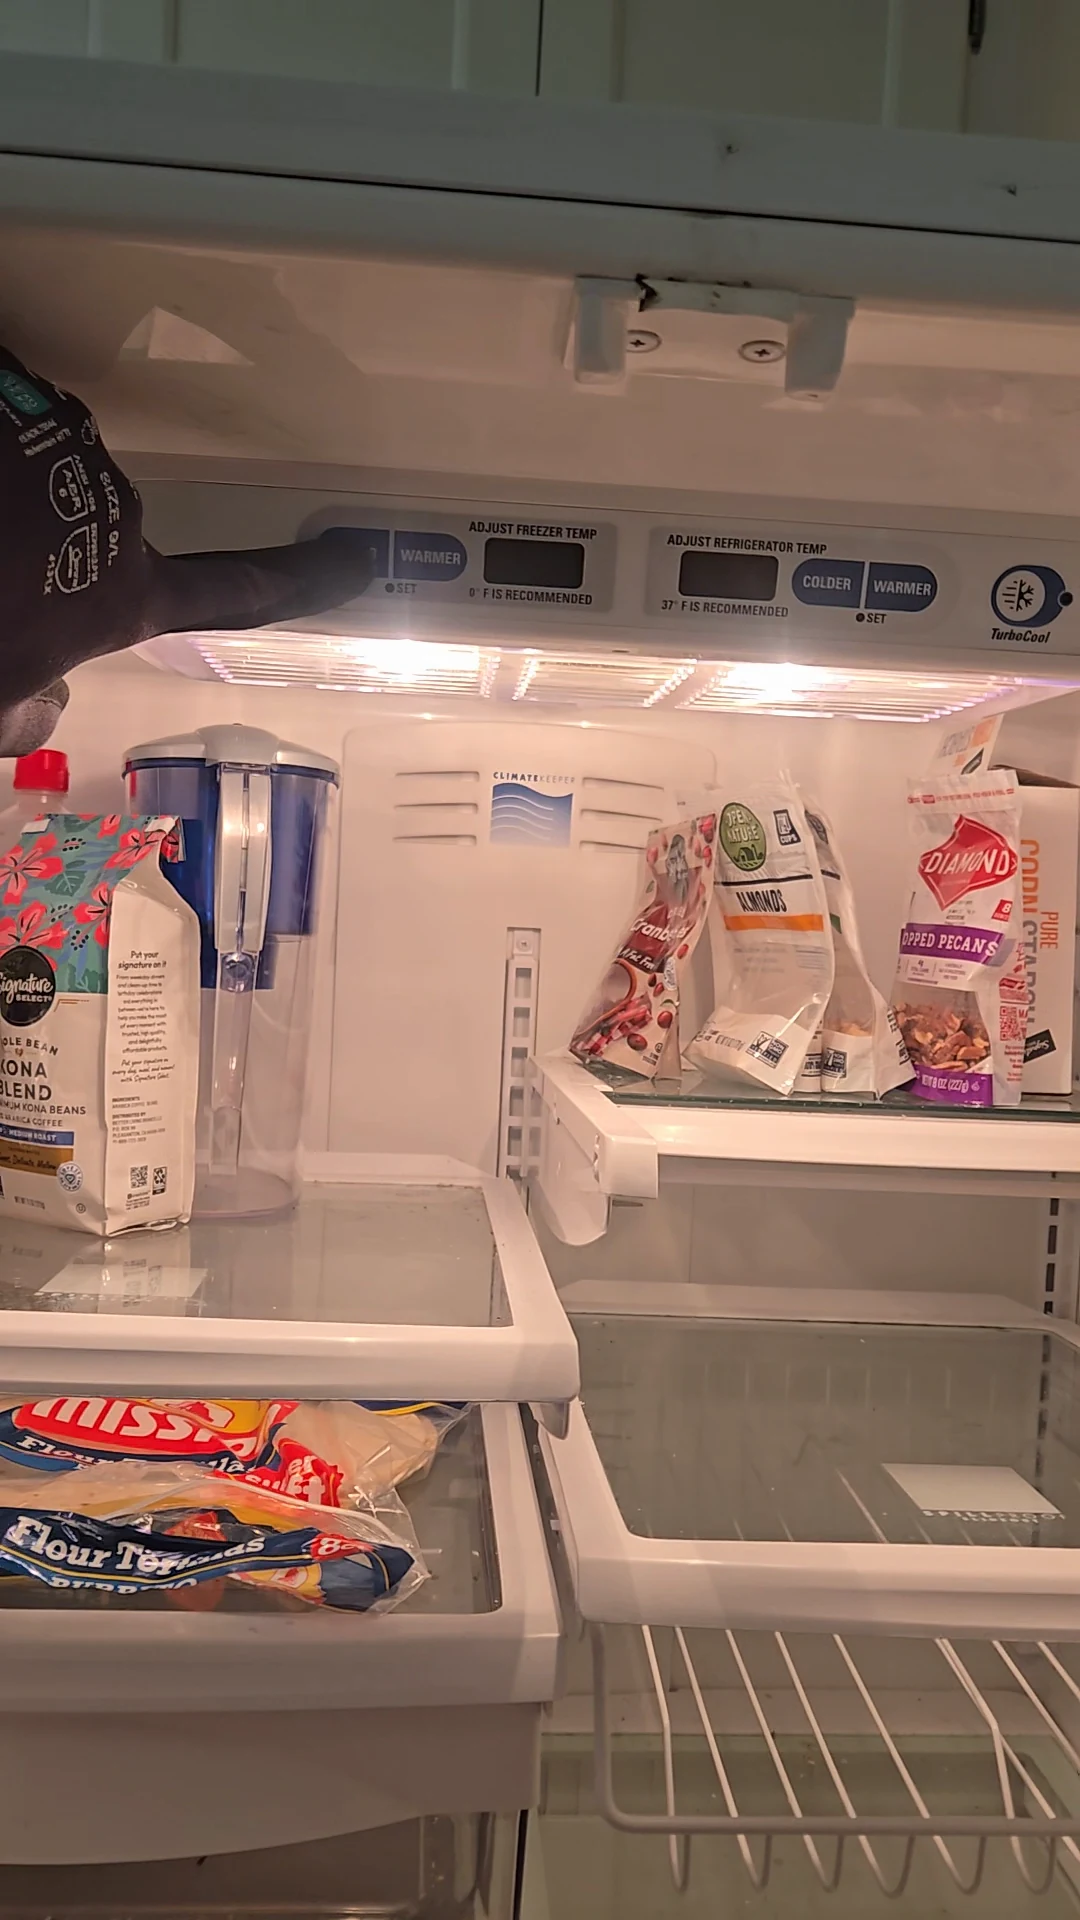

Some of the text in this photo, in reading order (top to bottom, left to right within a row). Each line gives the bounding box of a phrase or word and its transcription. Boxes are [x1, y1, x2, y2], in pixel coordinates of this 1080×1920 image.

[100, 472, 120, 524] SIZE
[469, 521, 597, 540] ADJUST FREEZER TEMP
[667, 534, 827, 555] ADJUST REFRIGERATOR TEMP
[400, 549, 461, 565] WARMER
[396, 583, 417, 594] SET
[803, 575, 851, 591] COLDER
[874, 579, 932, 596] WARMER
[483, 588, 490, 600] F
[492, 589, 502, 600] IS
[505, 590, 592, 605] RECOMMENDED
[681, 600, 688, 612] F
[690, 601, 700, 612] IS
[703, 602, 788, 618] RECOMMENDED
[867, 613, 887, 624] SET
[990, 628, 1050, 644] TurboCool
[493, 772, 576, 784] CLIMATEKEEPER
[781, 834, 798, 844] CUPS
[924, 849, 1010, 875] DIAMOND
[736, 889, 787, 912] ALMONDS
[1002, 903, 1012, 914] 8
[1040, 911, 1058, 949] PURE
[938, 934, 998, 956] PECANS
[130, 950, 159, 960] Put your
[118, 961, 152, 970] signature
[0, 1036, 58, 1056] OLE BEAN
[932, 1077, 938, 1088] 8
[938, 1078, 948, 1090] OZ
[948, 1080, 969, 1094] (227g)
[22, 1103, 46, 1114] KONA
[50, 1106, 86, 1114] BEANS
[32, 1118, 63, 1127] COFFEE
[34, 1132, 56, 1142] ROAST
[31, 1398, 257, 1458] miss
[16, 1436, 115, 1465] Flou
[6, 1516, 266, 1578] Flour Toras
[51, 1577, 198, 1595] BURRO
